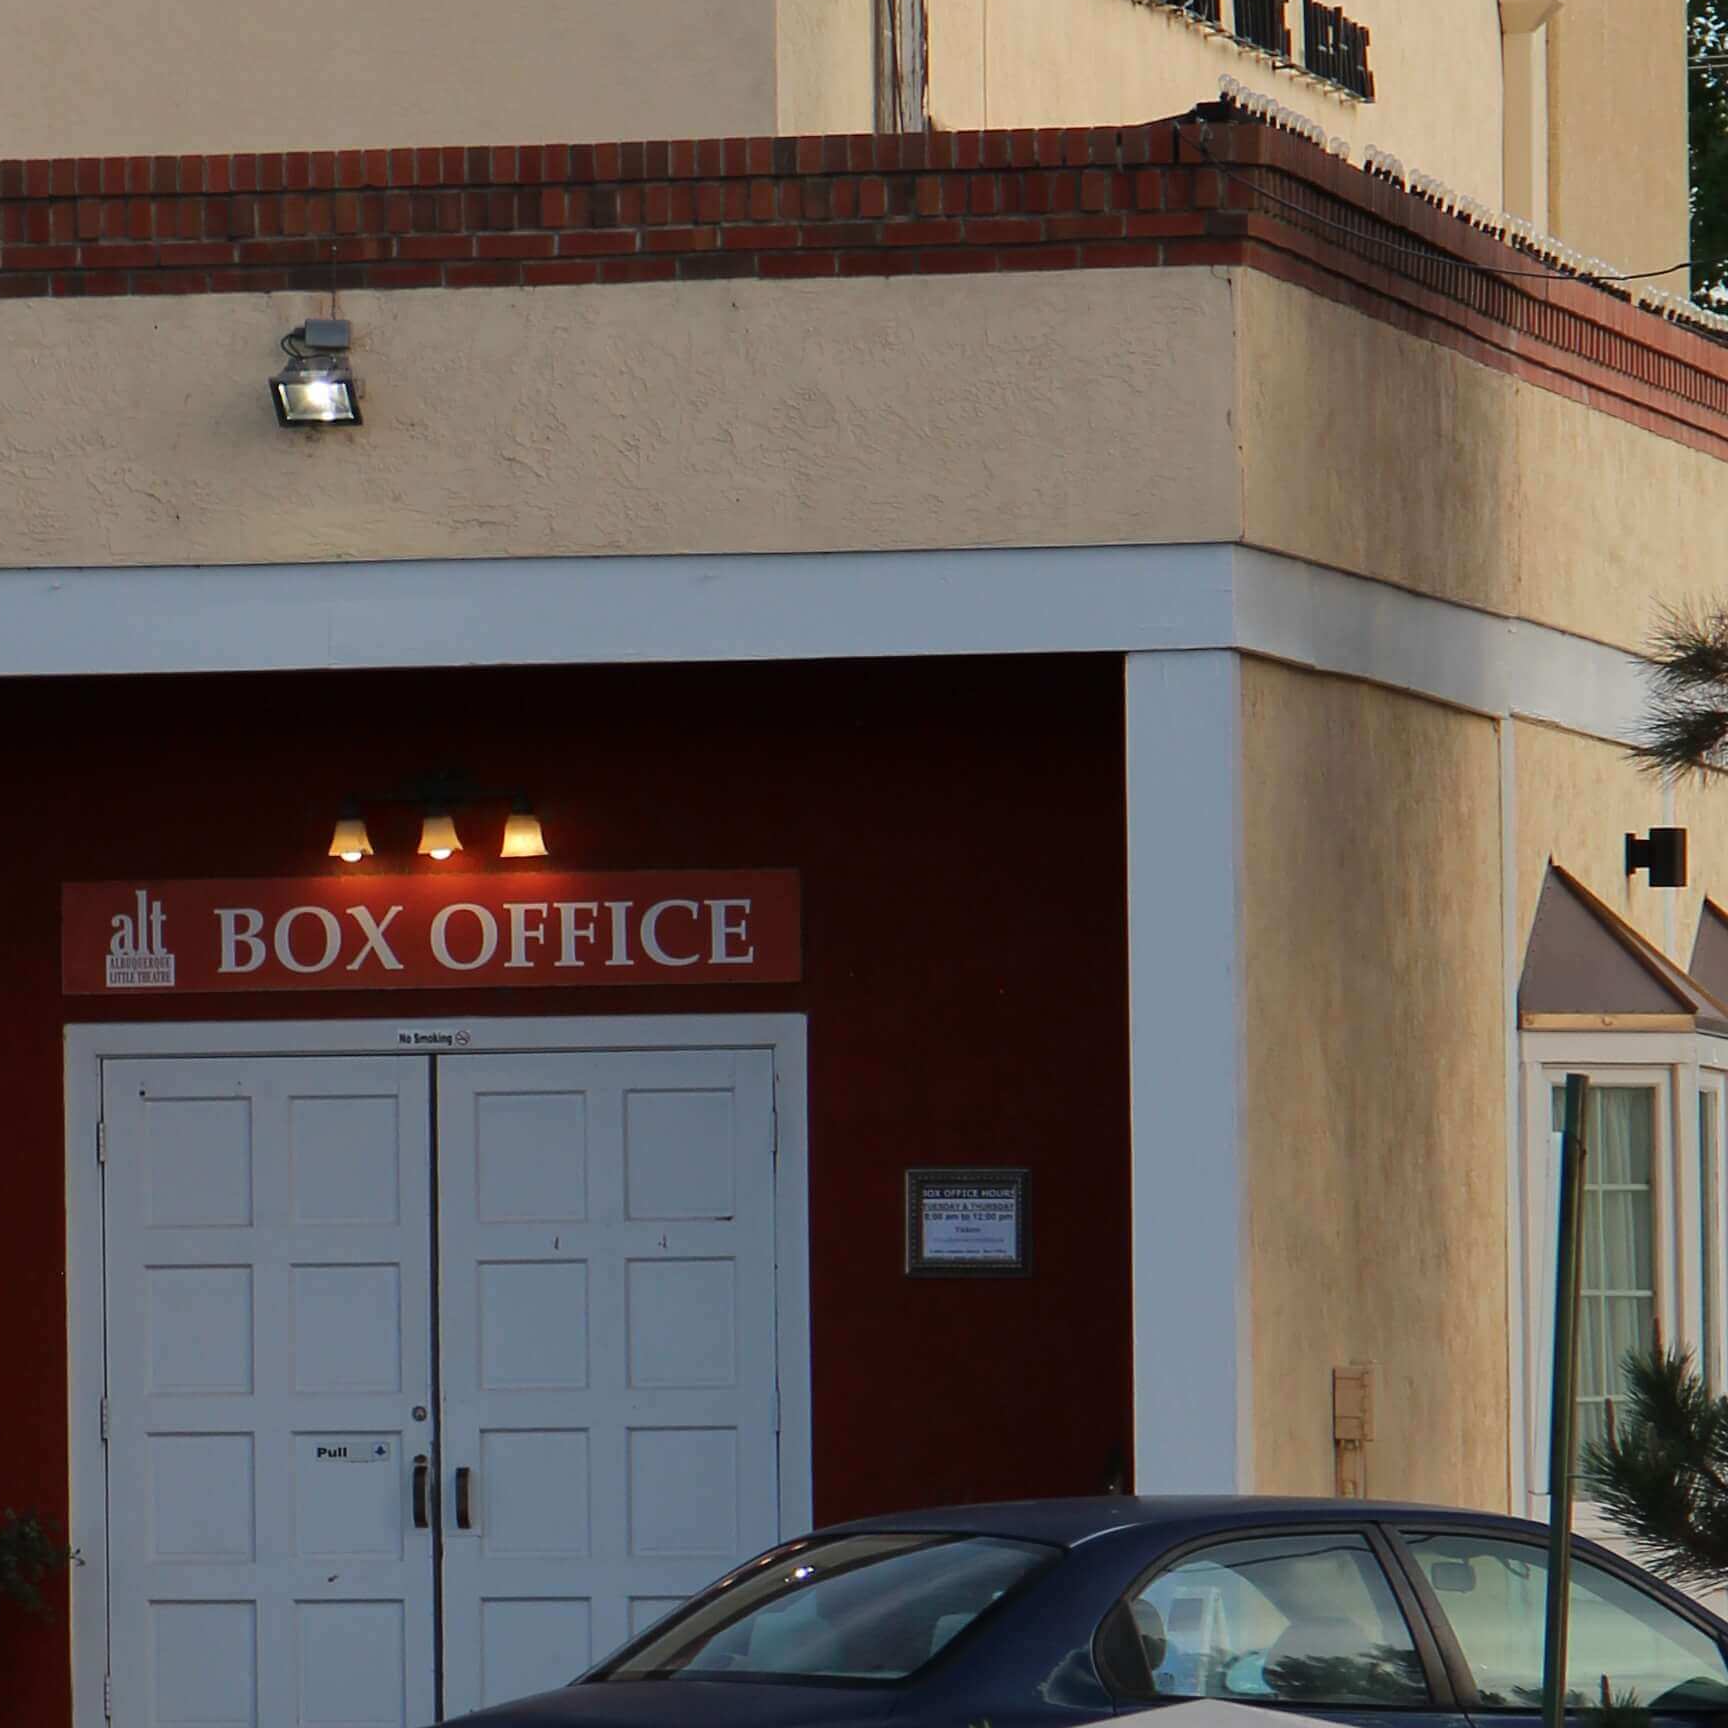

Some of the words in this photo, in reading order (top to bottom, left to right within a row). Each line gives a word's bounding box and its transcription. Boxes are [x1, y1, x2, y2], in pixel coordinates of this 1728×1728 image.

[110, 890, 167, 956] alt
[214, 906, 405, 974] BOX
[429, 899, 755, 972] OFFICE
[399, 1033, 412, 1044] No
[414, 1032, 453, 1046] Smoking
[316, 1446, 348, 1459] Pull
